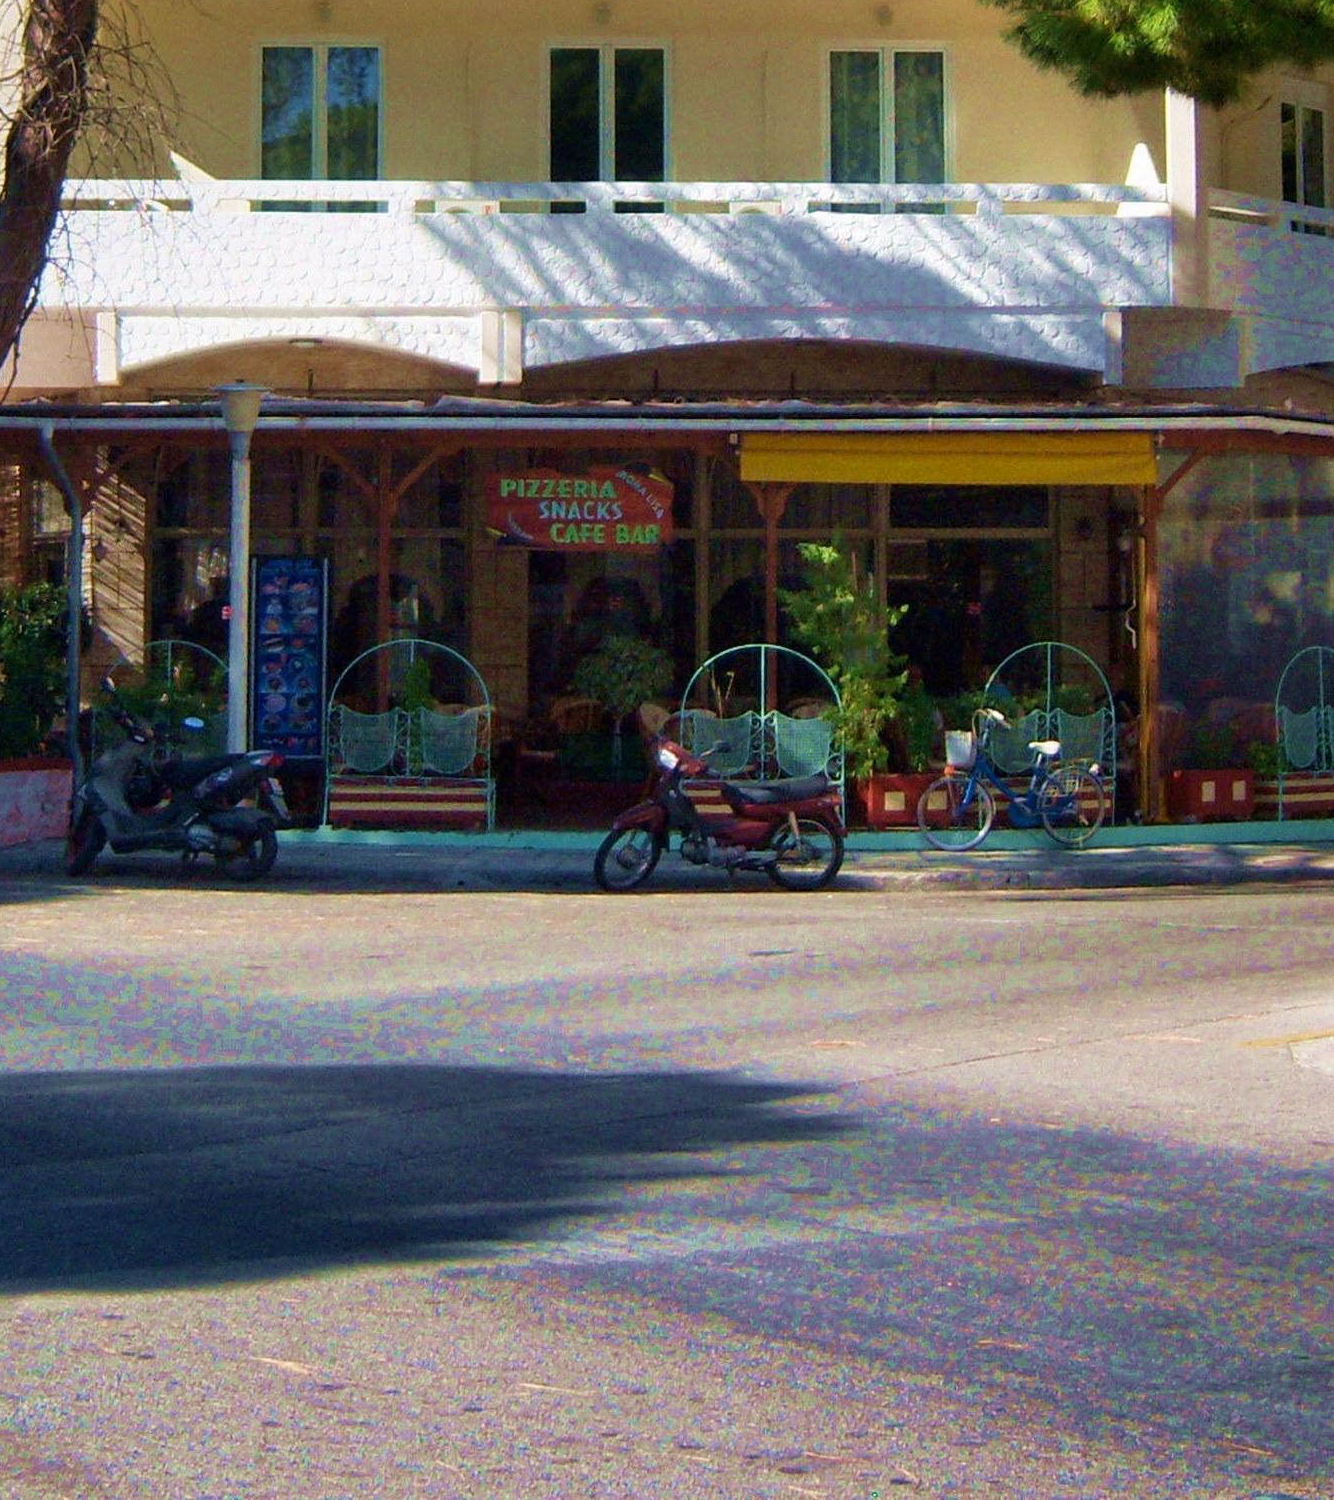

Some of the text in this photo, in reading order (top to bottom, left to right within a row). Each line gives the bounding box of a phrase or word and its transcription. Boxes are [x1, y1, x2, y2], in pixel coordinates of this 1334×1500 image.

[500, 479, 617, 499] PIZZERIA
[539, 500, 623, 520] SNACKS
[549, 522, 605, 544] CAFE
[615, 523, 661, 545] BAR
